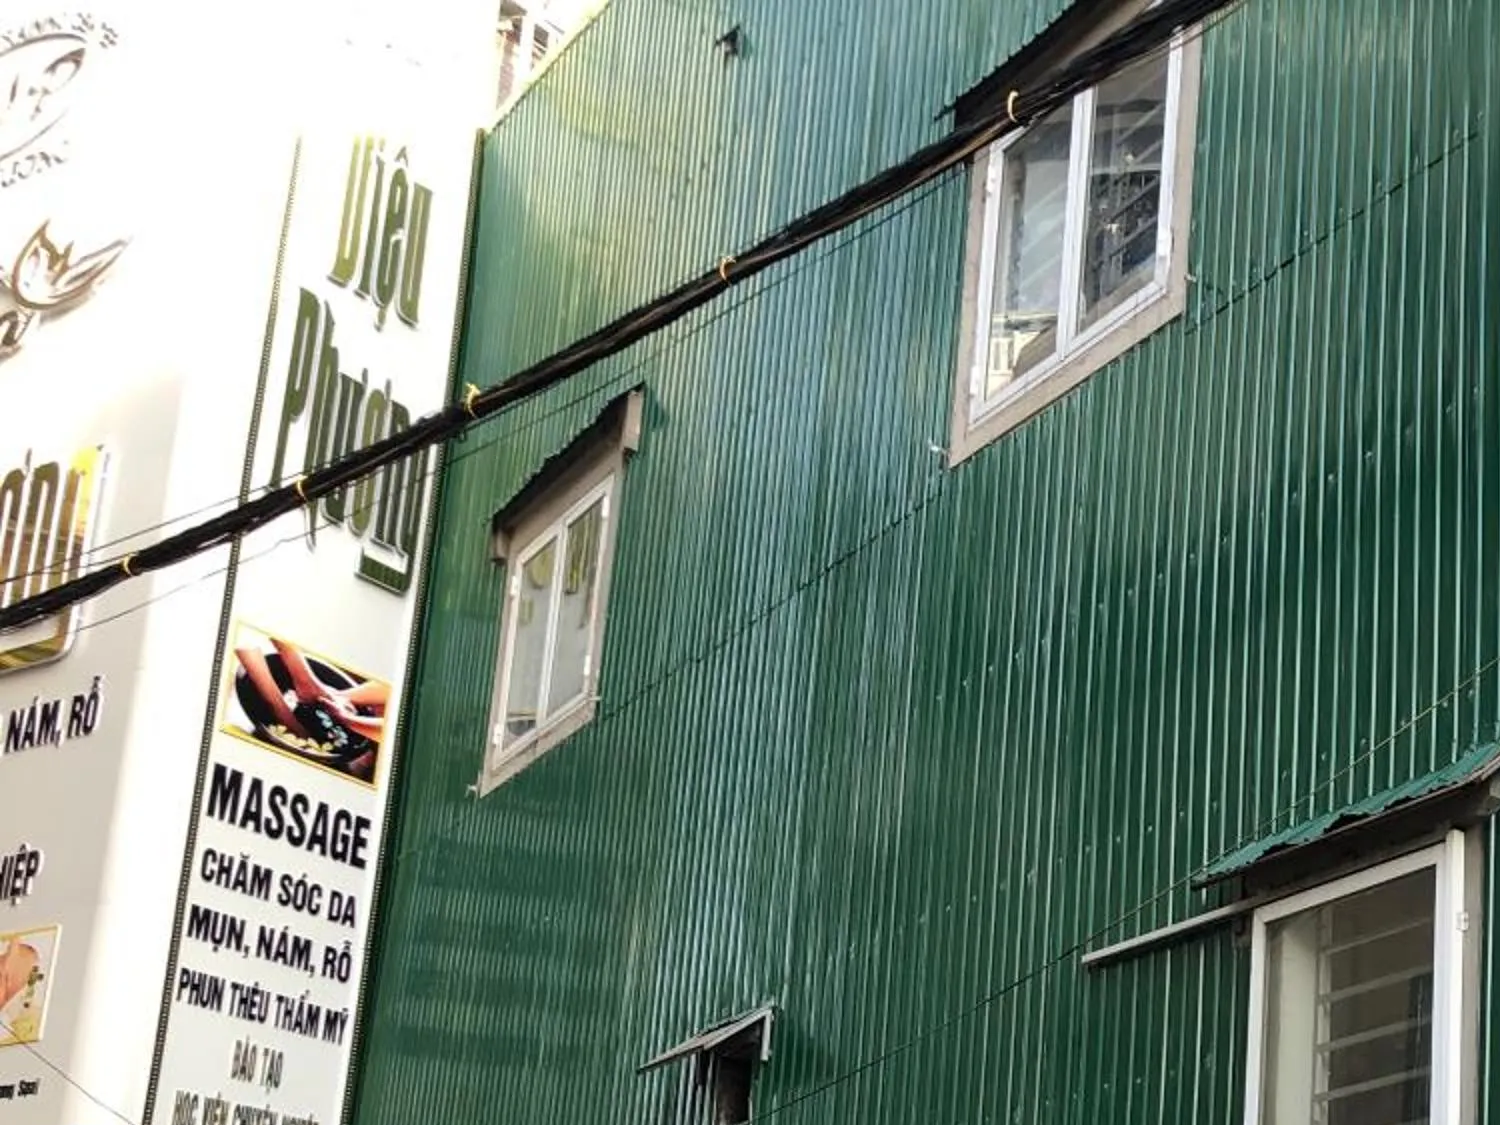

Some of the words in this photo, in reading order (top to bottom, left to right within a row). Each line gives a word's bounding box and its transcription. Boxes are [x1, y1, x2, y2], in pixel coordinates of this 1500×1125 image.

[206, 762, 372, 870] MASSAGE
[200, 847, 274, 902] CHĂM
[277, 873, 323, 917] SÓC
[326, 889, 357, 929] DA
[186, 903, 251, 959] MỤN,
[255, 924, 316, 979] NÁM,
[321, 939, 353, 984] RỖ
[175, 966, 227, 1013] PHUN
[228, 980, 272, 1024] THÊU
